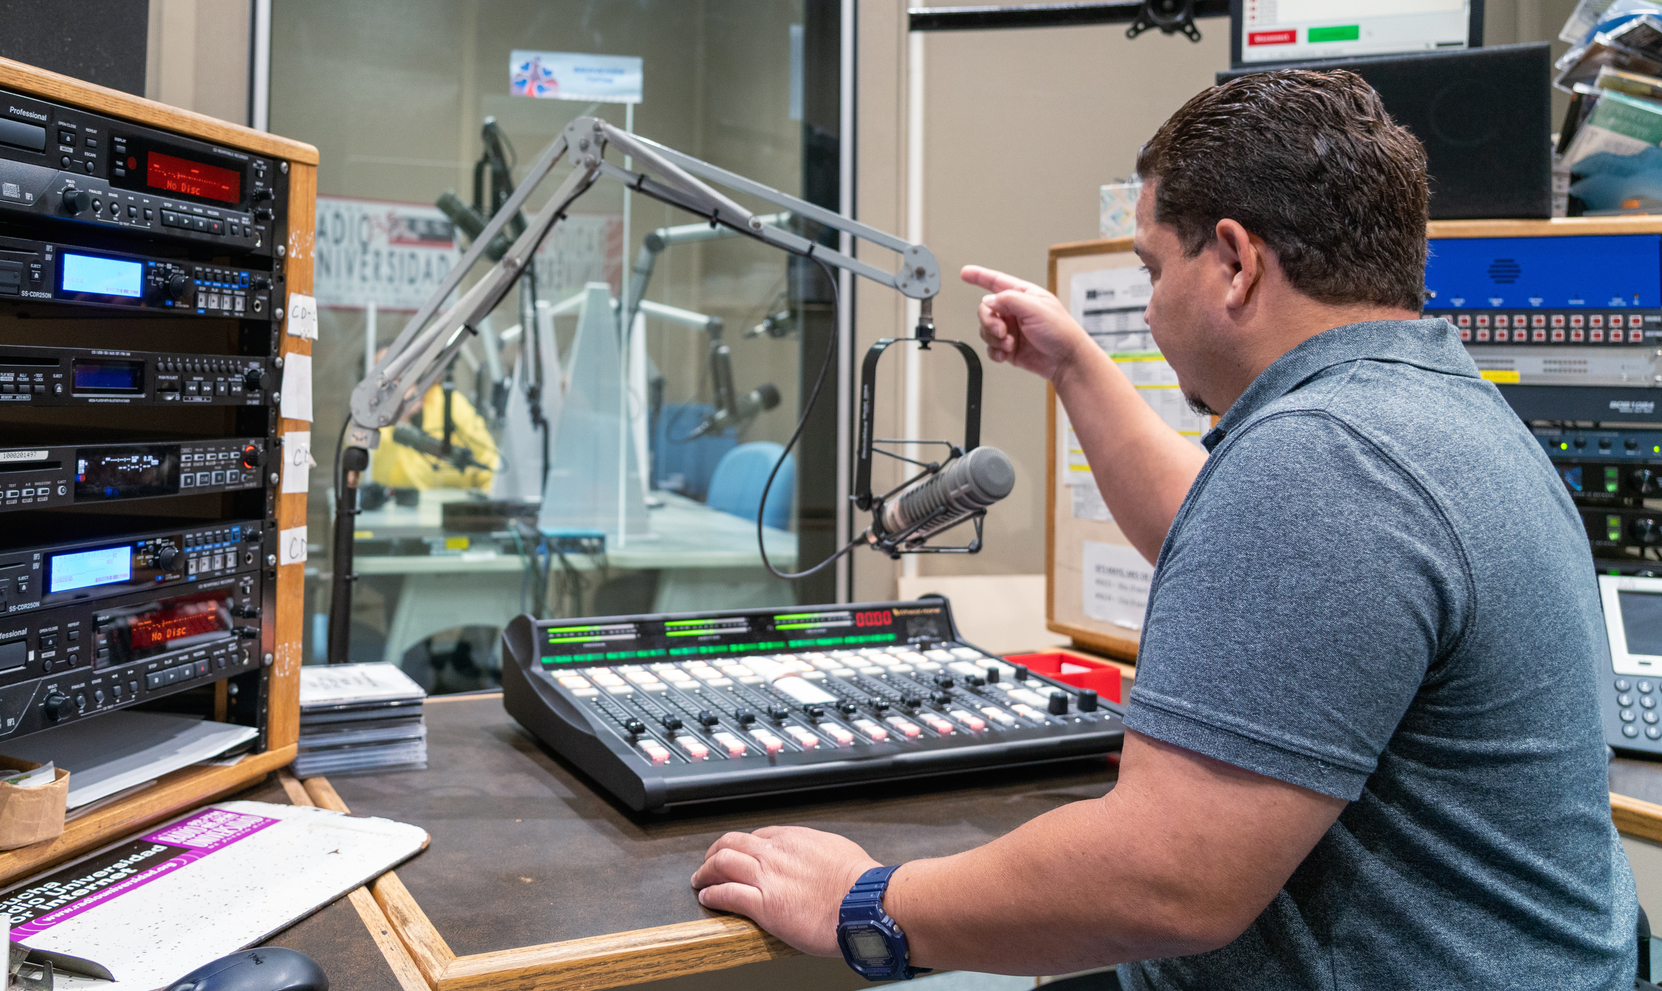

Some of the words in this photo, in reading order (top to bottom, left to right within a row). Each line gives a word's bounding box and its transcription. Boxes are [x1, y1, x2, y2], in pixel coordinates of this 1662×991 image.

[9, 106, 47, 121] Professional
[166, 180, 177, 190] No
[182, 183, 200, 196] Disc
[21, 290, 52, 299] SS-CDR250N
[9, 601, 40, 612] SS-CDR250N
[152, 632, 162, 642] No
[166, 627, 186, 638] Disc
[45, 844, 168, 897] Universidad
[10, 910, 34, 925] or
[35, 867, 138, 910] internet
[42, 862, 178, 922] www.radiouniversidad.org
